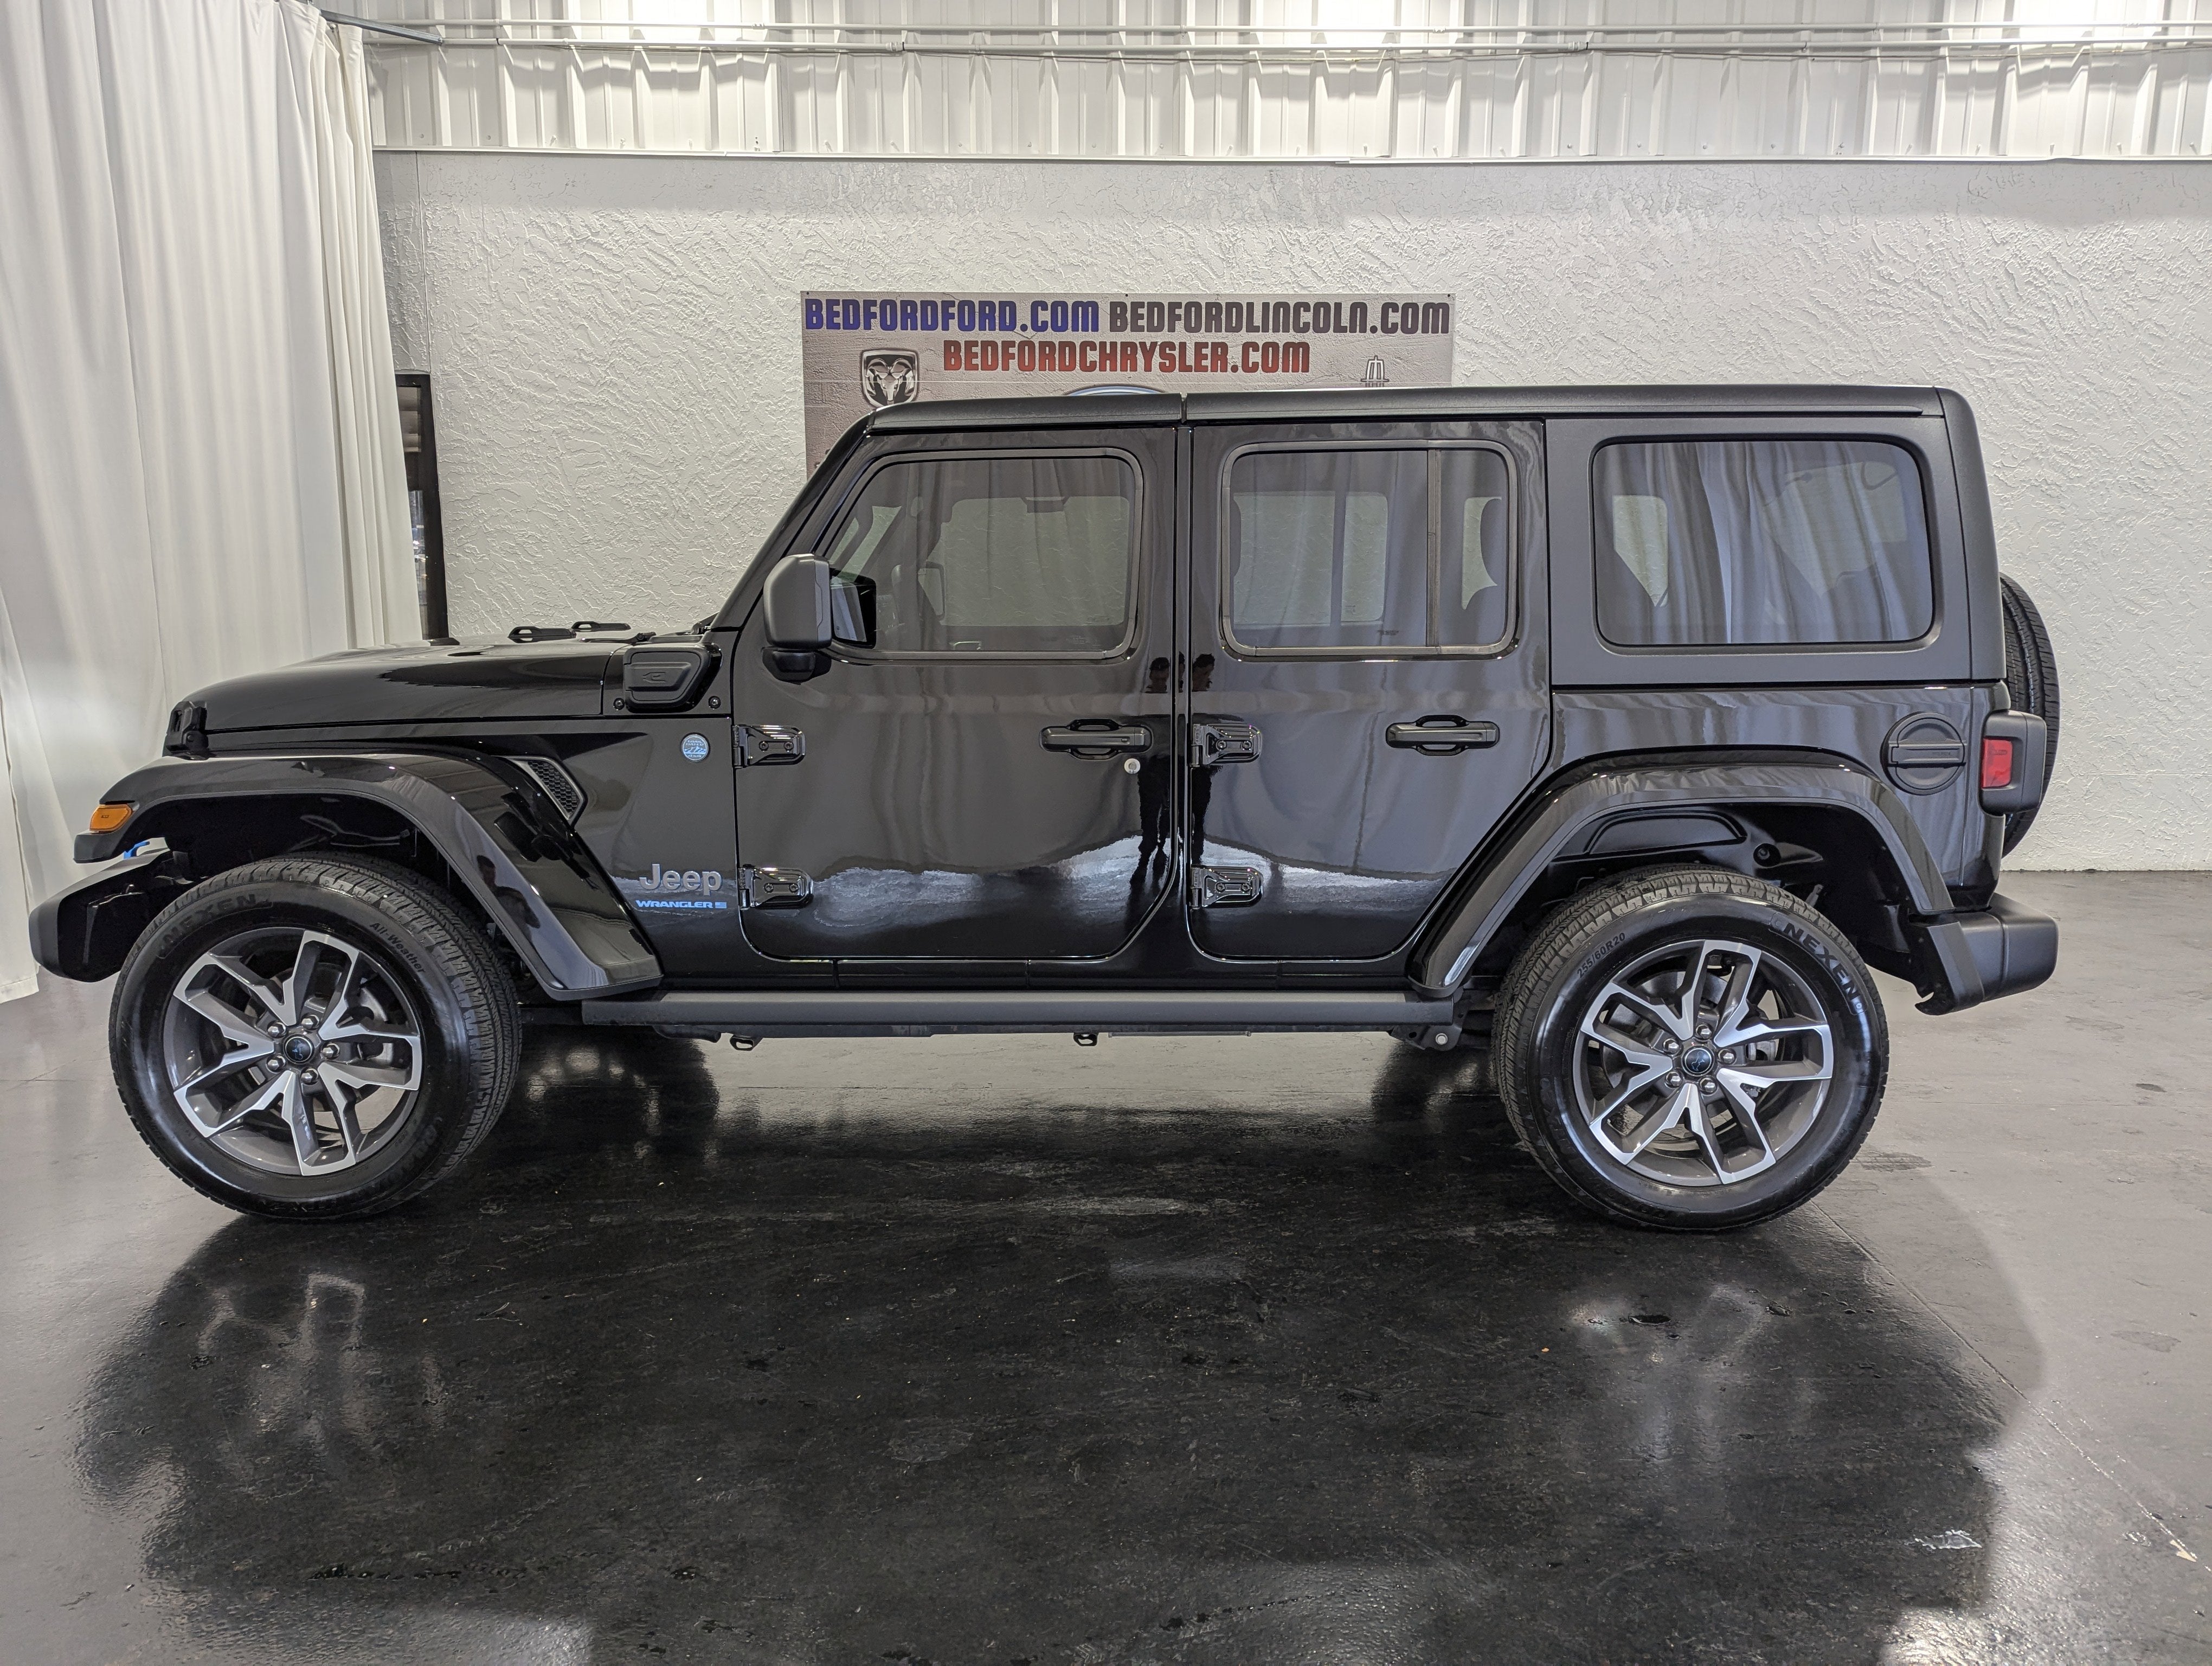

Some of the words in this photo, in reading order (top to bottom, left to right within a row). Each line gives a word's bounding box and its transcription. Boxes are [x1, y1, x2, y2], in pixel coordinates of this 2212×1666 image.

[805, 298, 1099, 332] BEDFORDFORD.COM
[1109, 301, 1449, 334] BEDFORDLINCOLN.COM
[944, 340, 1310, 373] BEDFORDCHRYSLER.COM
[639, 863, 722, 896] Jeep
[162, 893, 256, 945] NEXEN
[635, 900, 713, 909] WRANGLER
[369, 922, 426, 973] All-Weather
[1577, 932, 1625, 978] 255/60R20
[1783, 922, 1861, 1001] NEXEN
